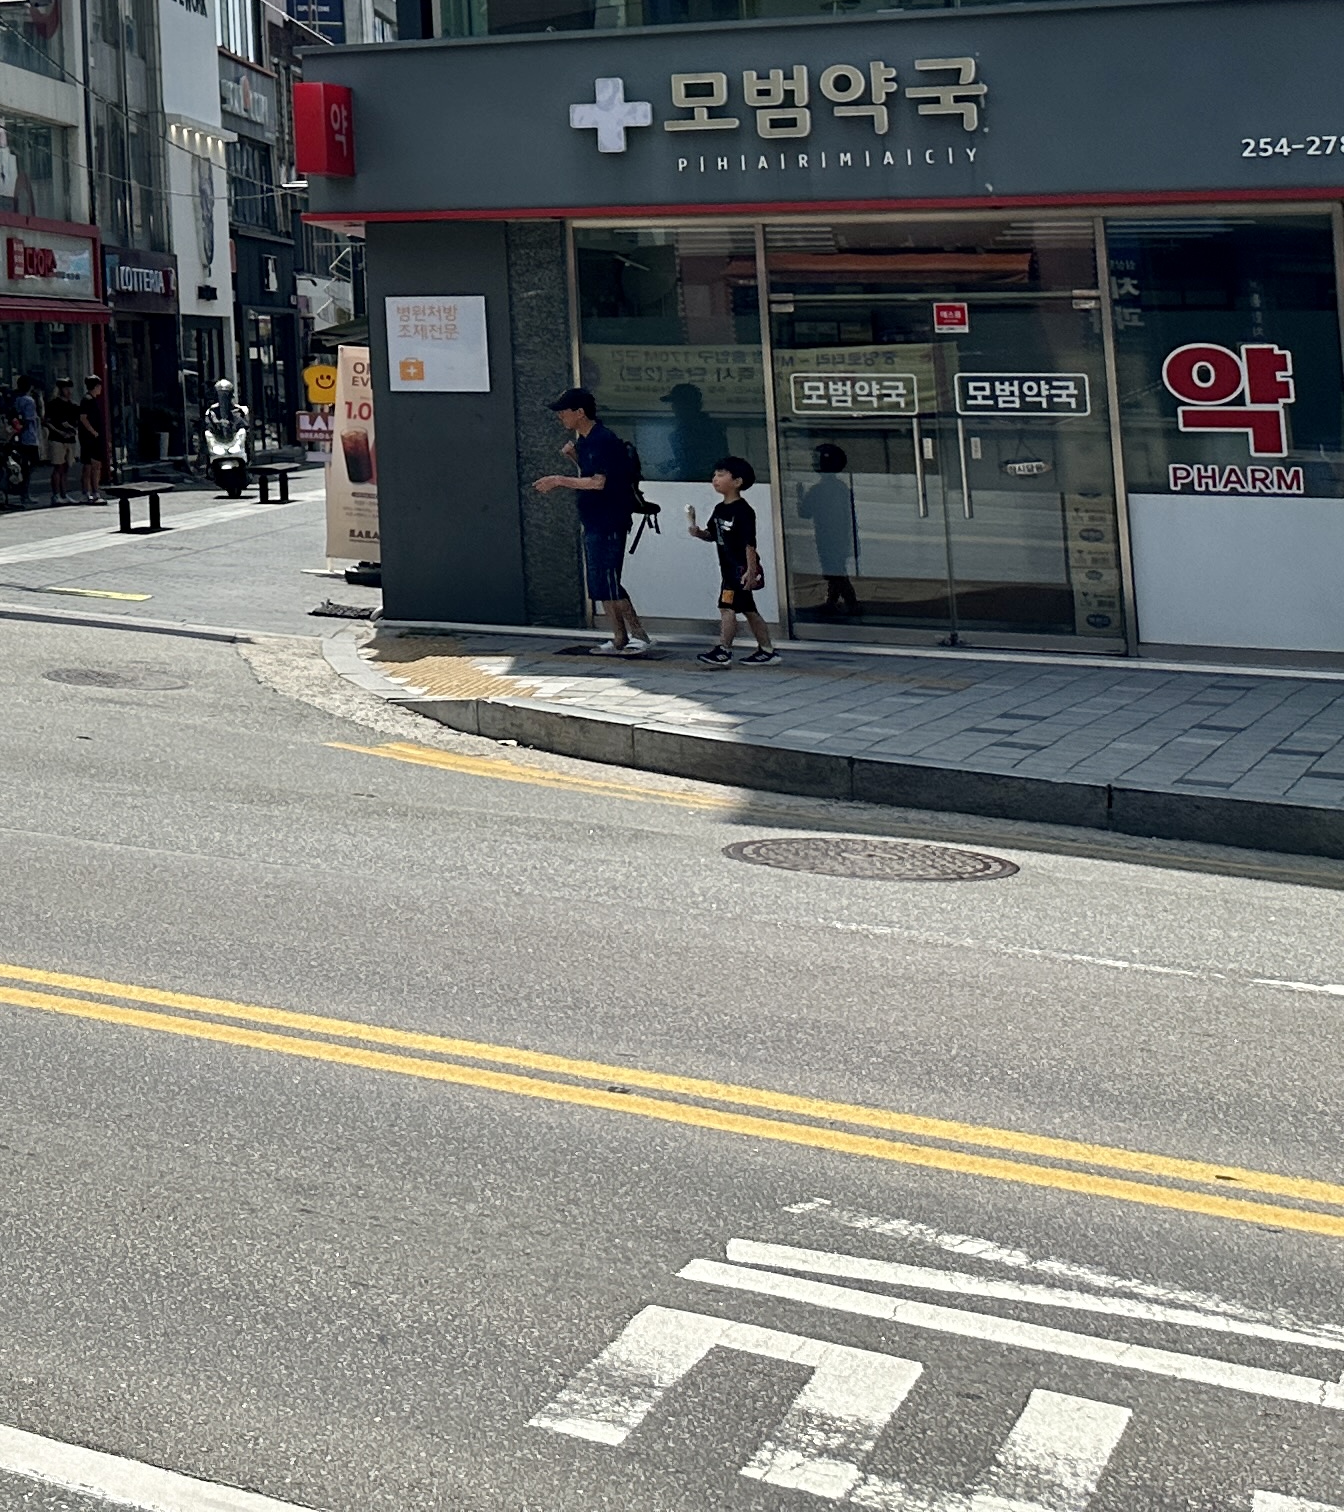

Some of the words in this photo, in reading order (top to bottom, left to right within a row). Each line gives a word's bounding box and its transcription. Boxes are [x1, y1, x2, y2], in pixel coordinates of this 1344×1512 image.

[664, 57, 988, 139] 모범약국
[330, 103, 348, 157] 약
[396, 303, 459, 322] 병원처방
[397, 323, 460, 342] 조제전문
[802, 380, 907, 409] 모범약국
[966, 379, 1079, 410] 모범약국
[1162, 342, 1296, 458] 약
[1168, 463, 1304, 494] PHARM
